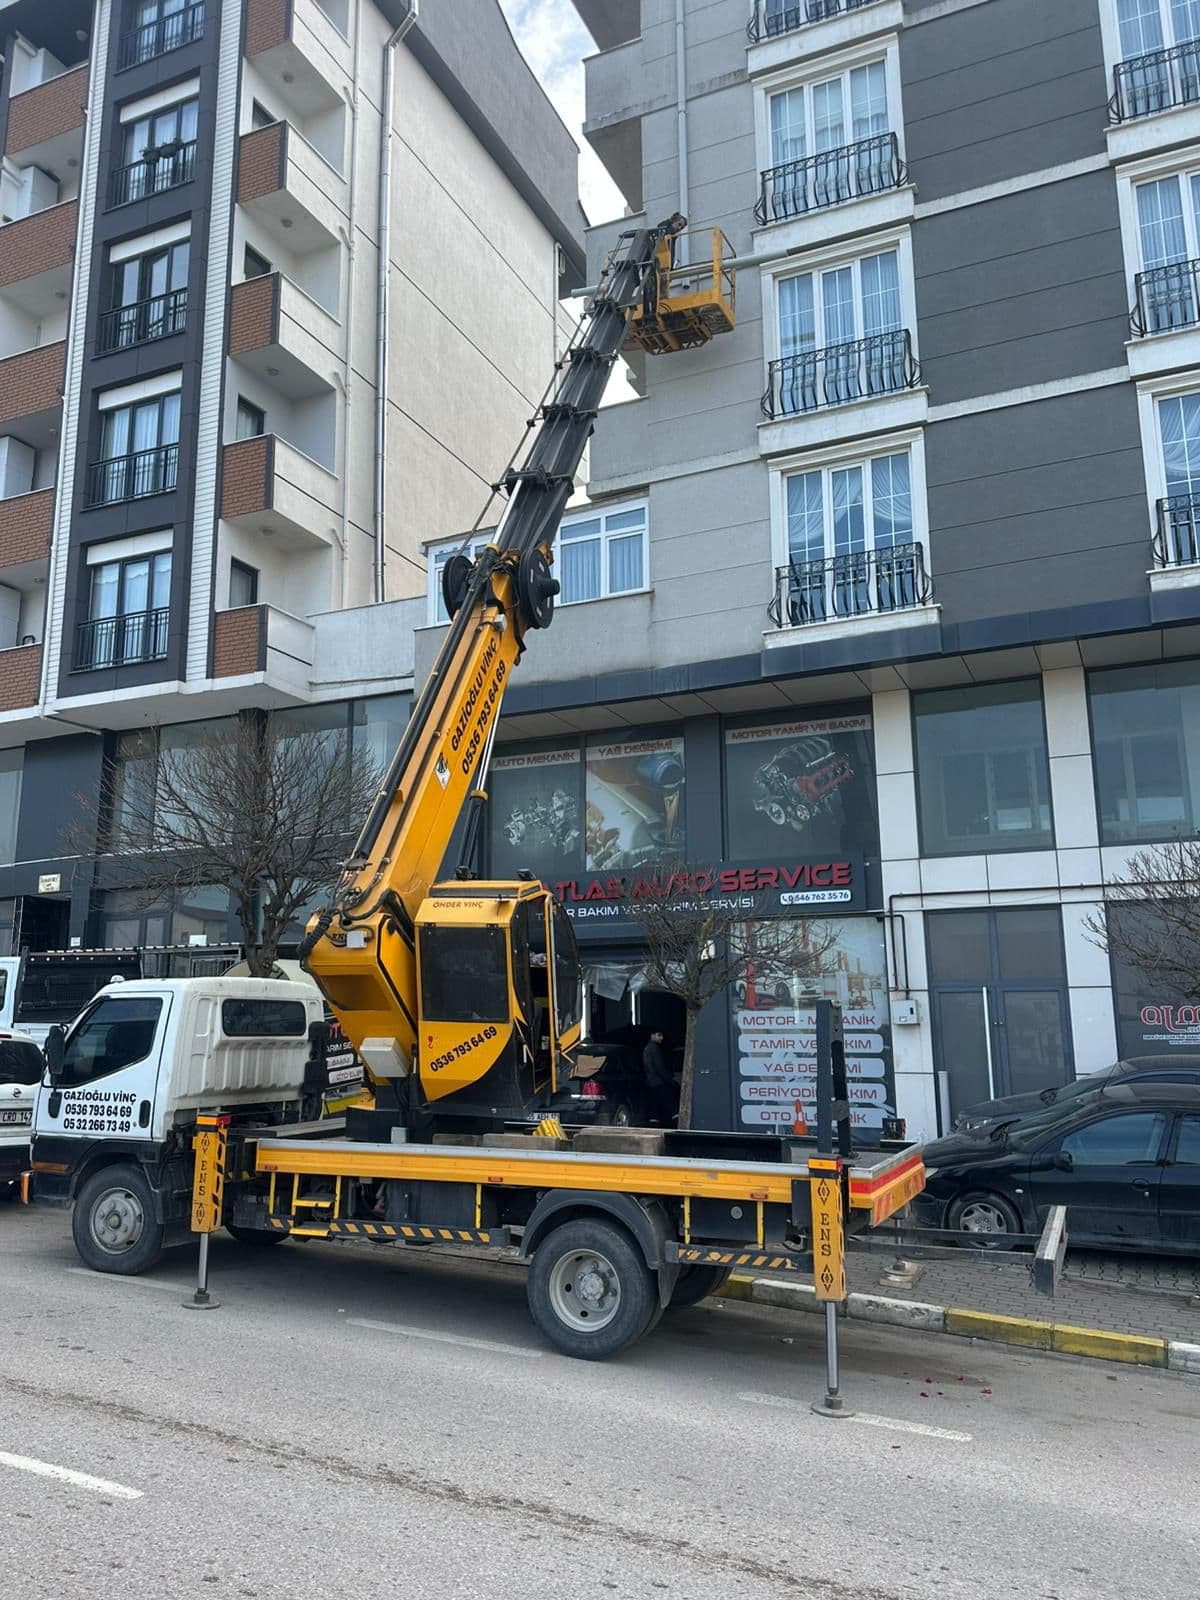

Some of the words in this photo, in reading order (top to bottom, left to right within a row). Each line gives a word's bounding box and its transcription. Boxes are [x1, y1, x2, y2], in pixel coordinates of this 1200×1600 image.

[451, 673, 484, 752] GAZİOĞLU
[480, 637, 497, 675] VİNÇ
[462, 731, 481, 775] 0536
[477, 702, 492, 734] 793
[488, 679, 500, 702] 64
[495, 660, 506, 681] 69
[731, 728, 772, 740] MOTOR
[811, 722, 827, 732] VE
[829, 719, 866, 730] BAKIM
[495, 757, 526, 769] AUTO
[527, 751, 576, 765] MEKANİK
[541, 877, 623, 902] TLAS
[719, 862, 852, 892] SERVICE
[811, 893, 826, 901] 762
[838, 891, 849, 899] 76
[577, 905, 619, 918] BAKIM
[742, 1015, 797, 1026] MOTOR
[808, 1013, 876, 1026] MANİK
[430, 1051, 455, 1072] 0536
[452, 1041, 472, 1058] 793
[470, 1033, 485, 1047] 64
[483, 1025, 497, 1040] 69
[749, 1037, 796, 1049] TAMİR
[800, 1039, 818, 1049] VE
[763, 1061, 794, 1073] YAĞ
[63, 1089, 111, 1102] GAZİOĞLU
[113, 1090, 137, 1105] VİNÇ
[748, 1085, 818, 1098] PERİYODİ
[65, 1103, 88, 1115] 0536
[89, 1104, 105, 1116] 793
[106, 1105, 118, 1117] 64
[120, 1105, 132, 1117] 69
[760, 1111, 792, 1121] OTO
[88, 1119, 105, 1131] 266
[106, 1119, 117, 1131] 73
[118, 1120, 131, 1132] 49
[198, 1160, 208, 1196] ENS
[819, 1212, 832, 1257] ENS
